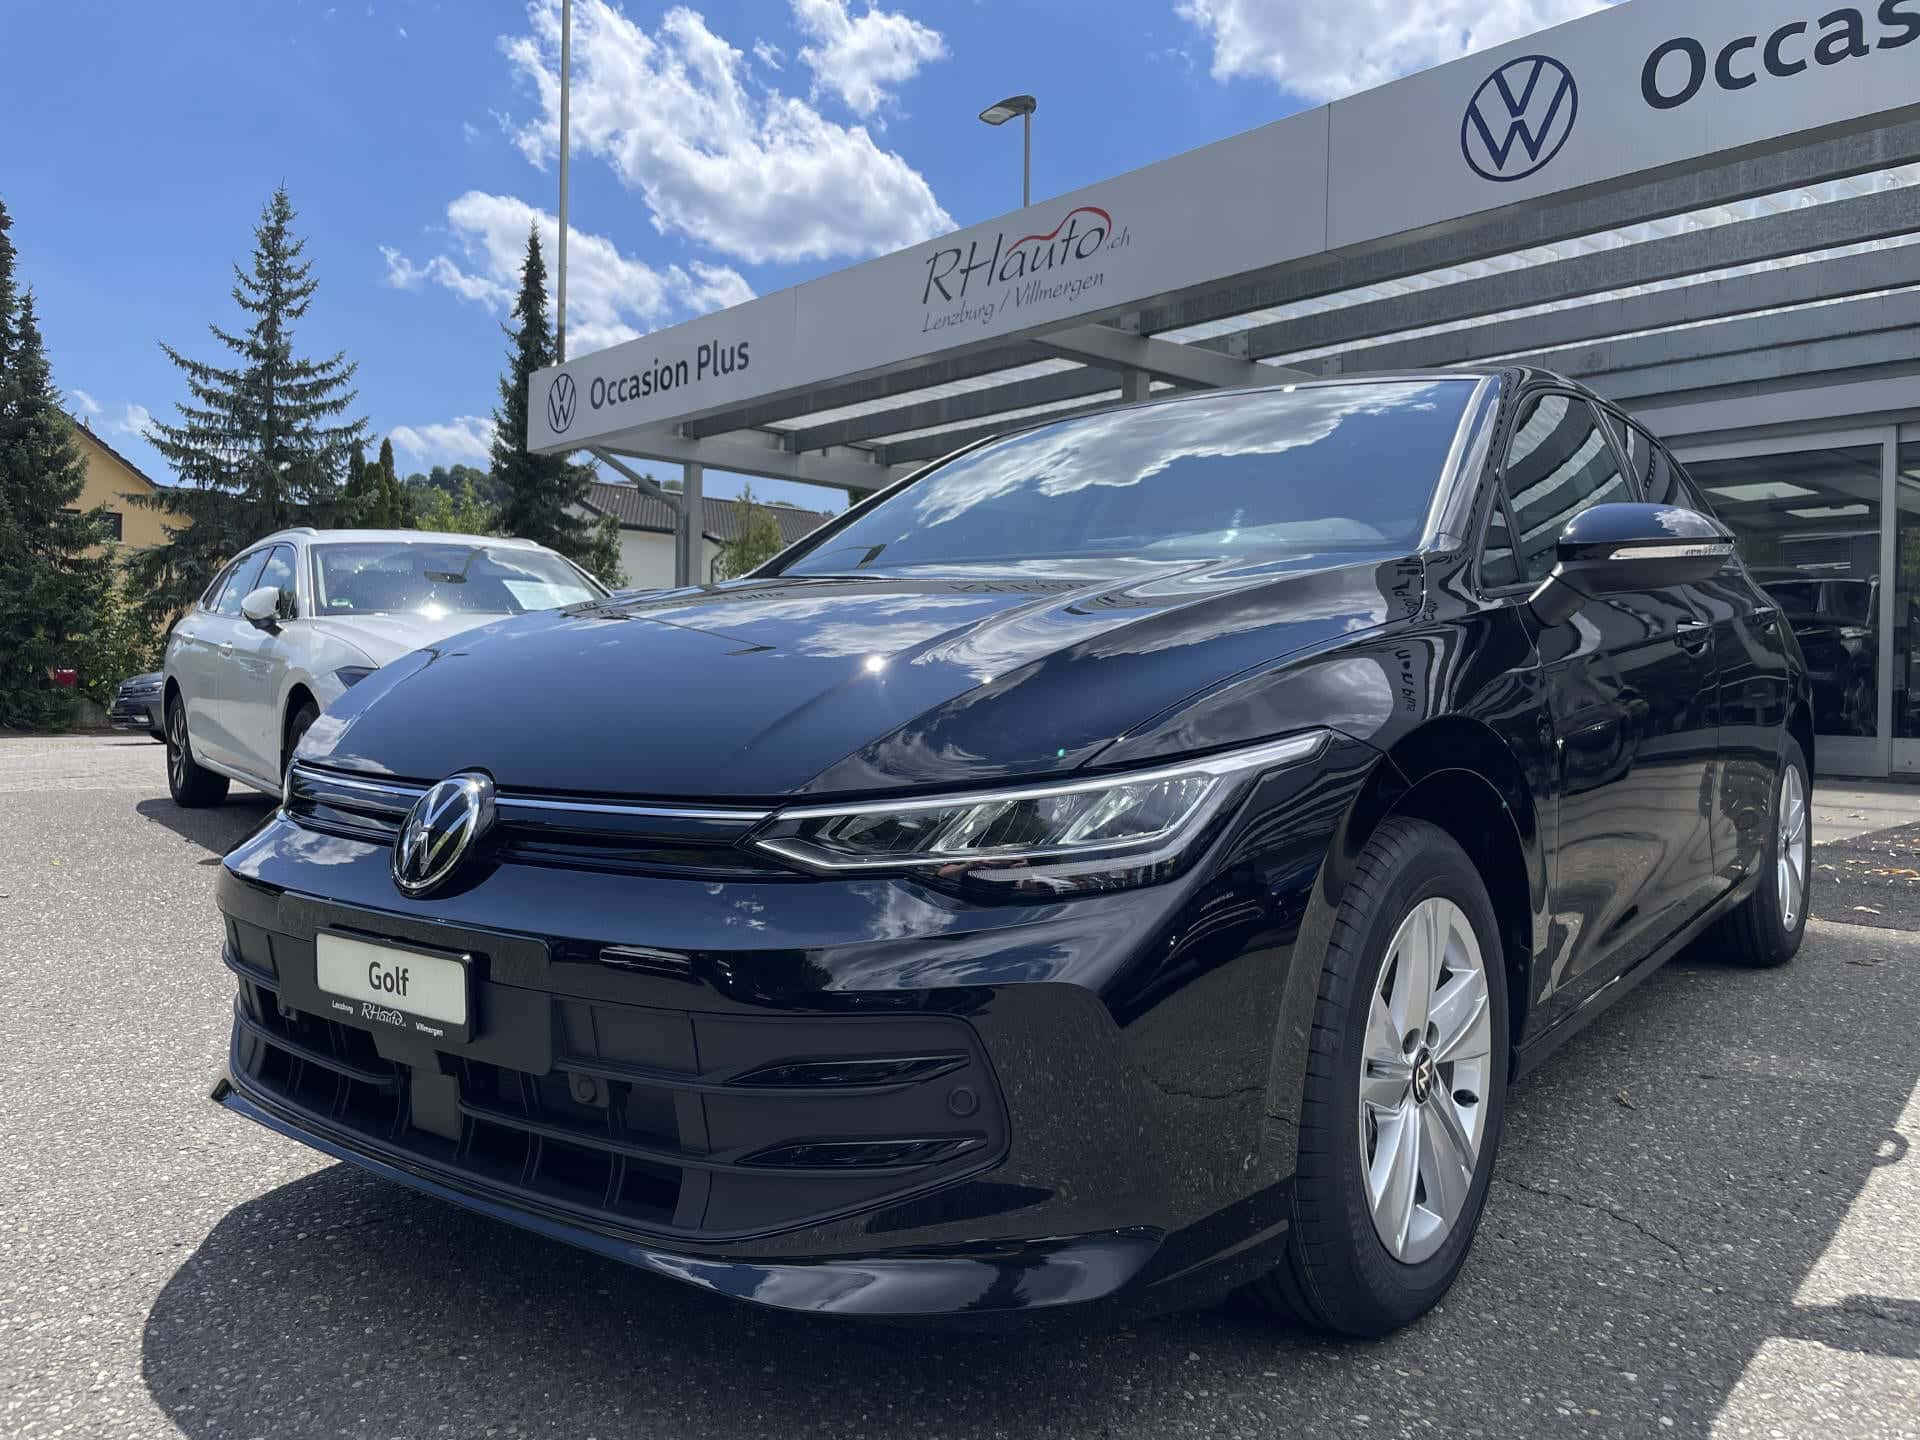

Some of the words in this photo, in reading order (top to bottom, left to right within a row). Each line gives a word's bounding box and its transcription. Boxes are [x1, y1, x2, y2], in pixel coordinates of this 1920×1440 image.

[1640, 0, 1920, 110] Occas
[921, 301, 996, 333] Lenzburg
[1015, 271, 1105, 308] Villmergen
[590, 358, 689, 410] Occasion
[696, 339, 750, 381] Plus
[368, 961, 409, 997] Golf
